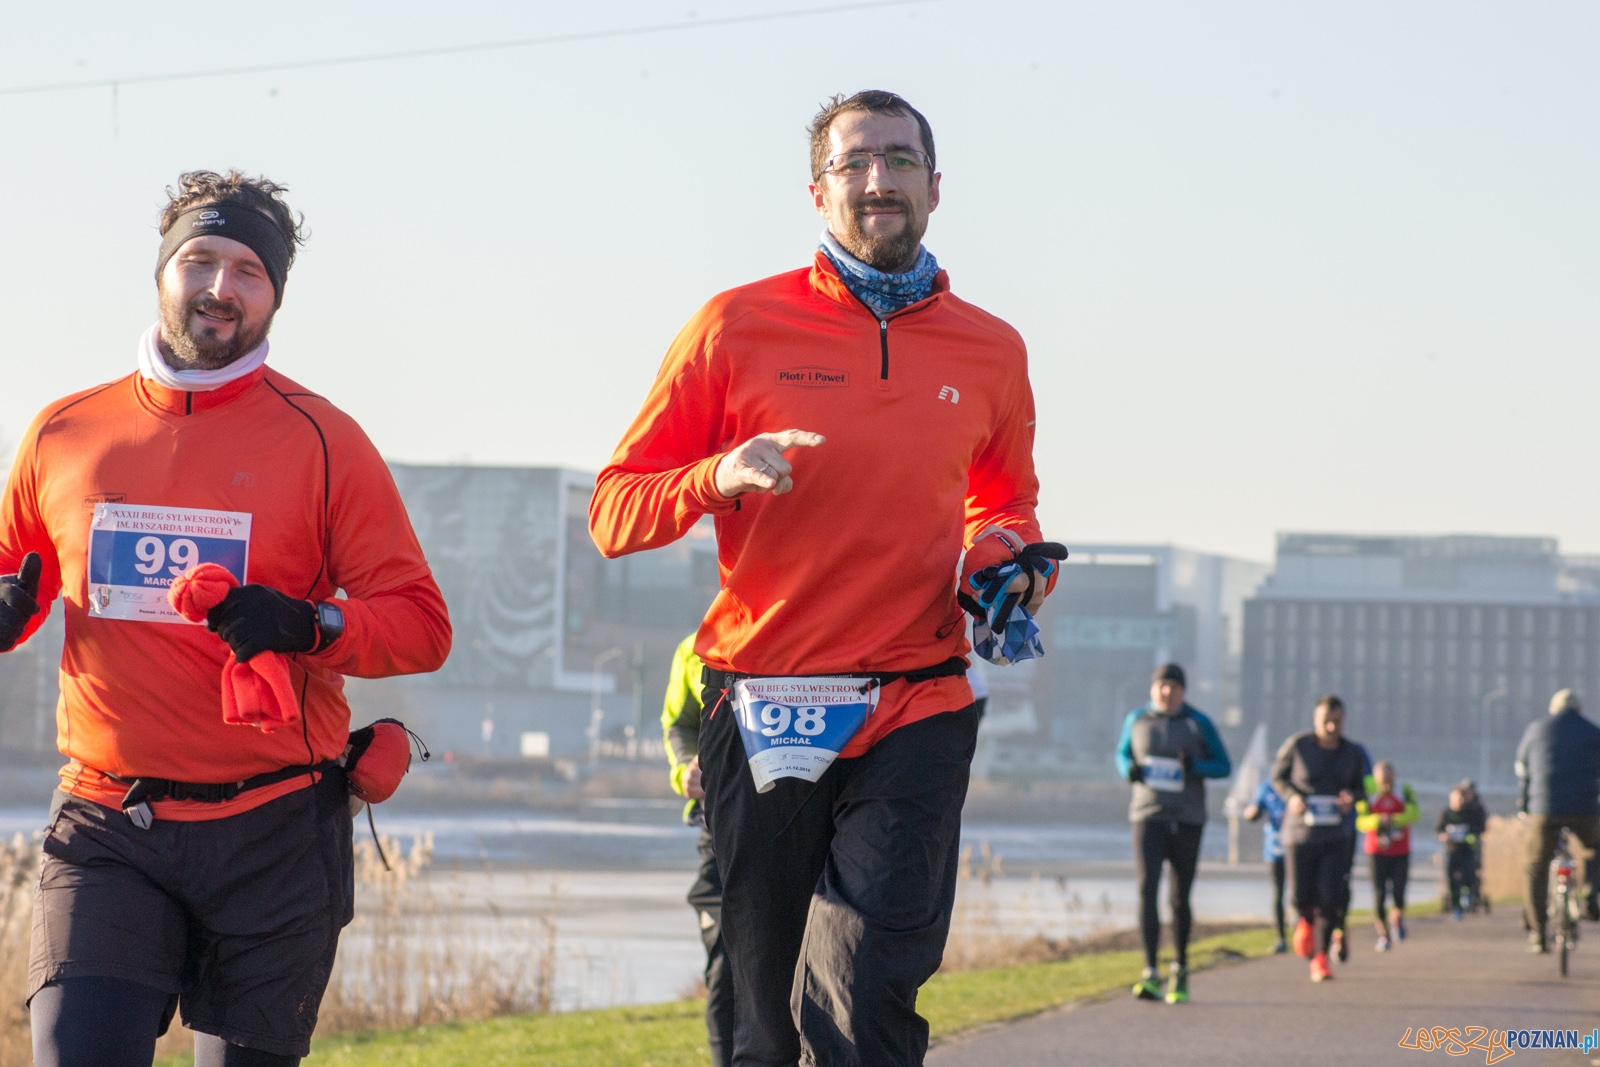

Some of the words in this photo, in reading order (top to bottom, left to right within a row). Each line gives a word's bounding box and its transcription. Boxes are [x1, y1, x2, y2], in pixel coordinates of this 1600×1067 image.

[779, 372, 805, 381] Piotr
[808, 371, 812, 381] i
[141, 512, 164, 521] BIEG
[165, 513, 240, 526] SYLWESTROWY
[116, 520, 131, 529] IM.
[132, 522, 182, 532] RYSZARDA
[184, 525, 234, 536] BURGIELA
[134, 535, 200, 577] 99
[143, 576, 173, 587] MARC
[766, 684, 789, 693] BIEG
[790, 684, 860, 693] SYLWESTROW
[810, 695, 862, 704] BURGIELA
[760, 703, 826, 737] 98
[770, 736, 812, 746] MICHAŁ
